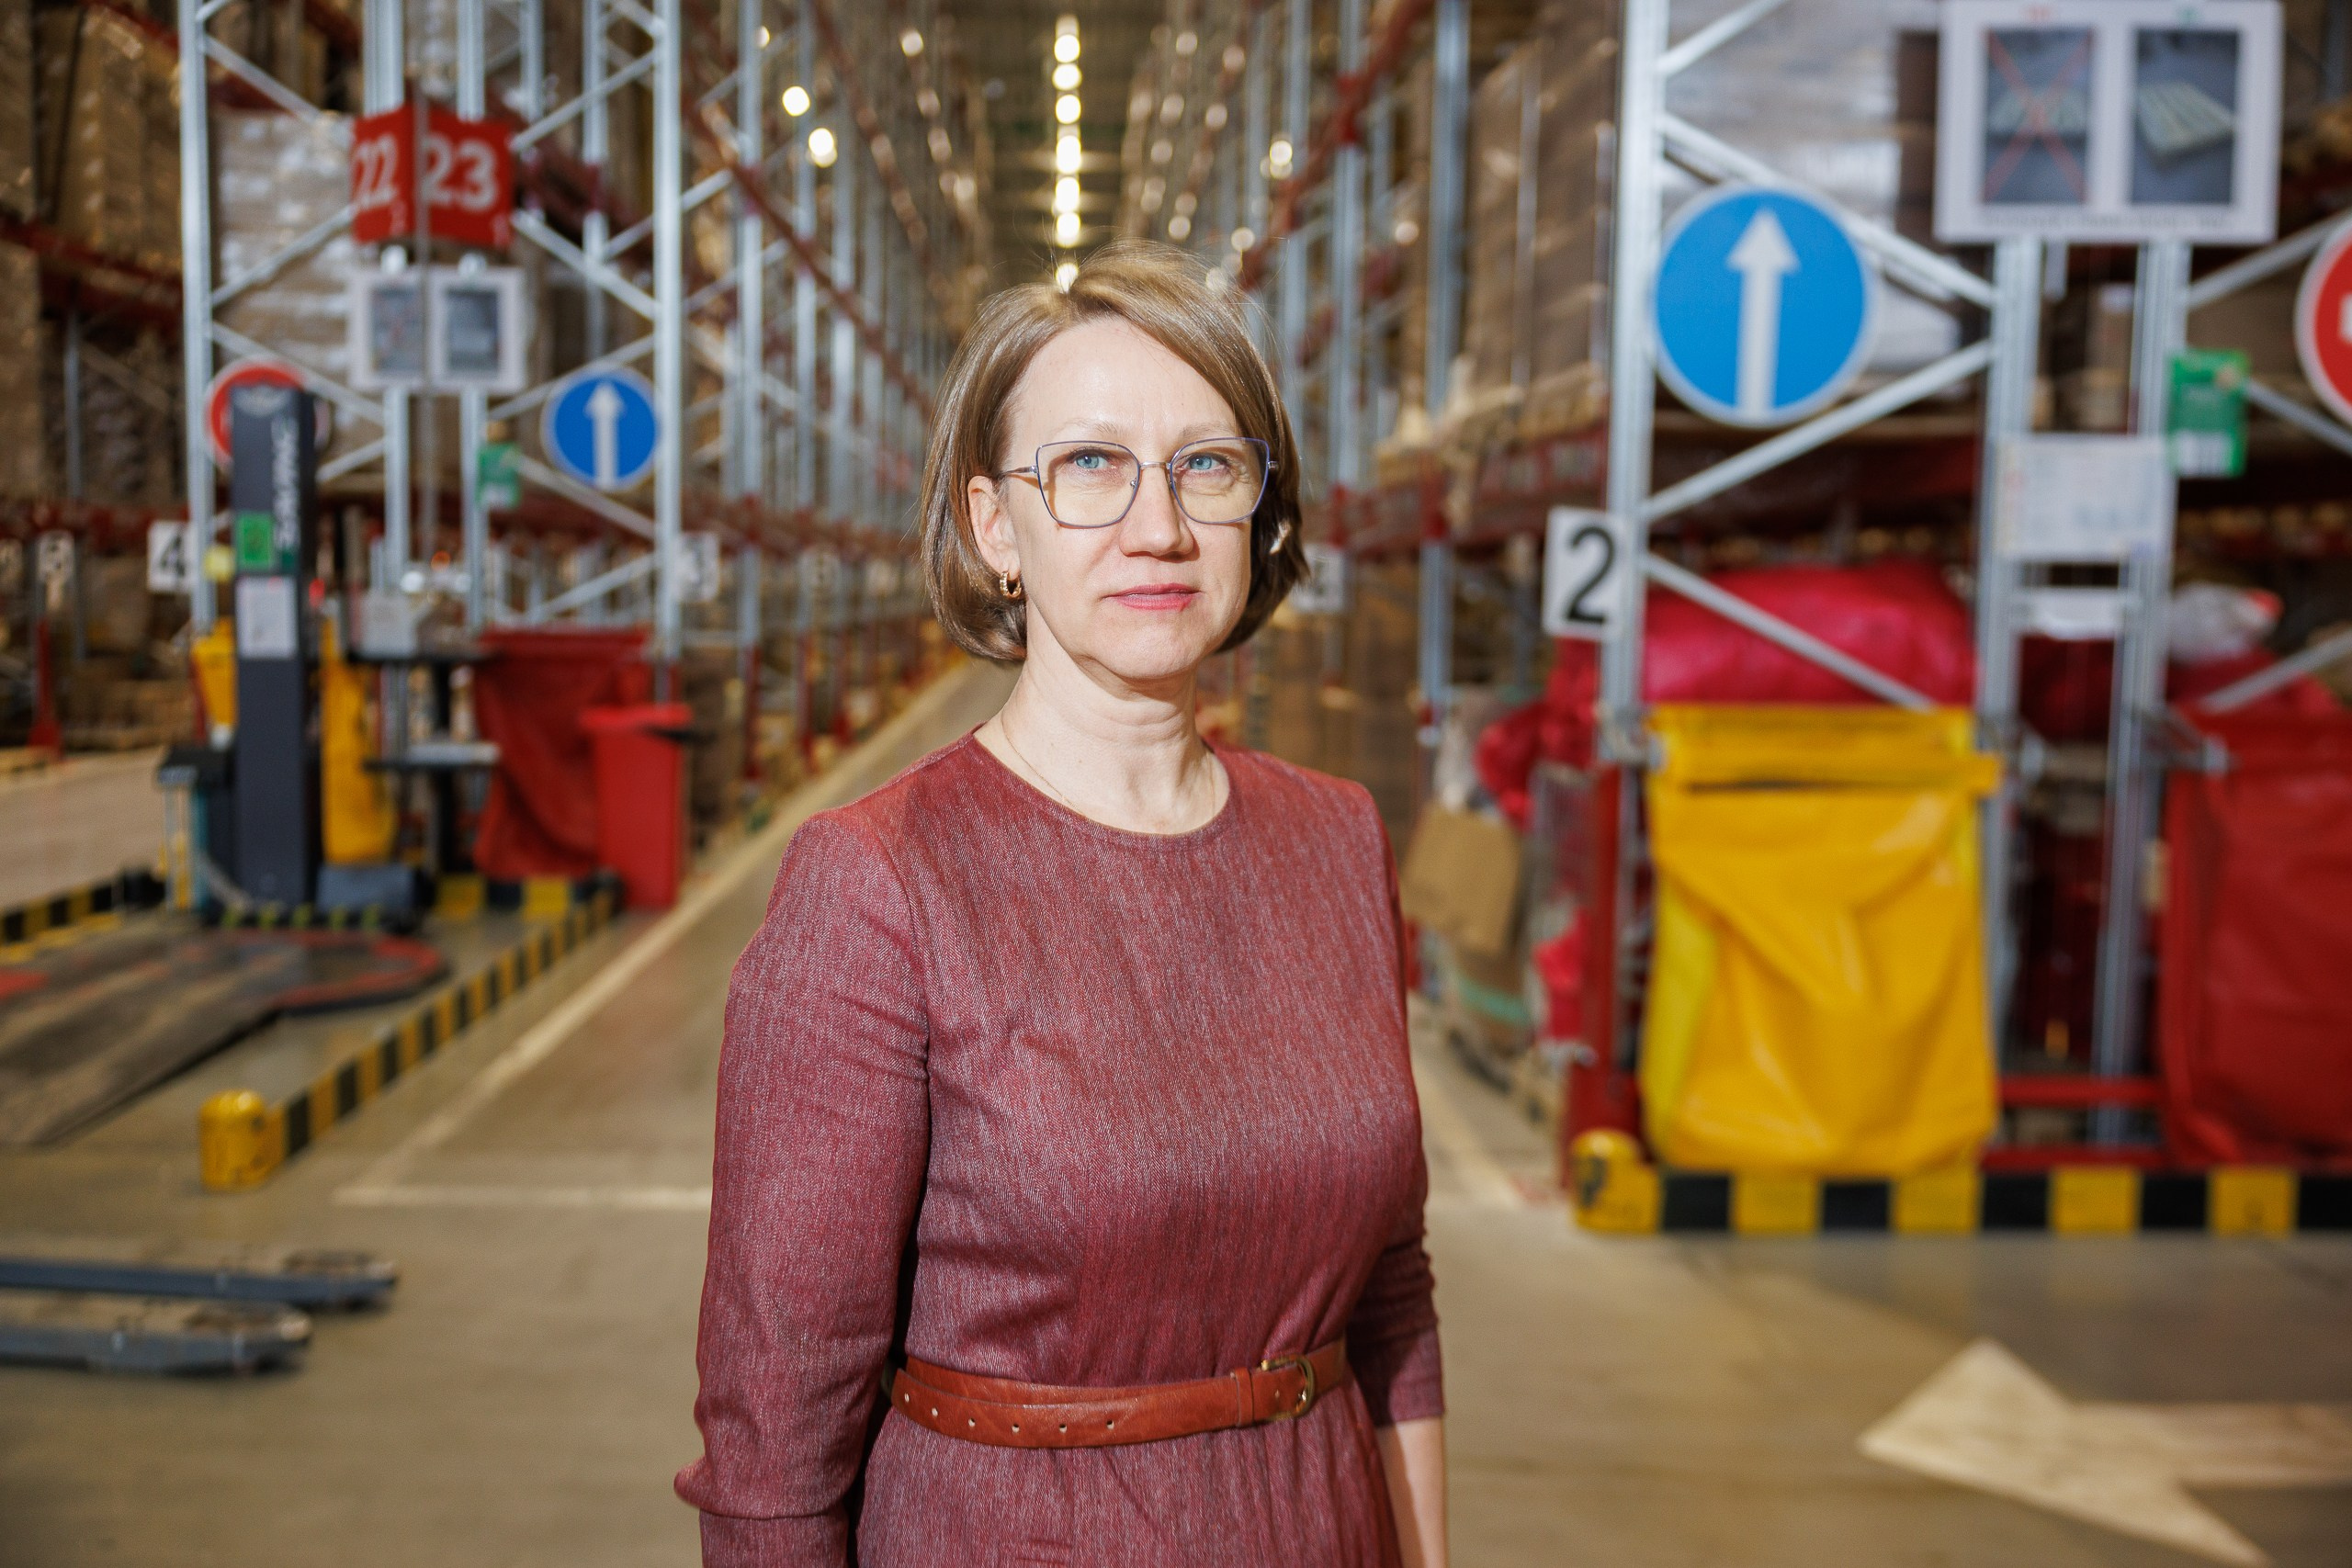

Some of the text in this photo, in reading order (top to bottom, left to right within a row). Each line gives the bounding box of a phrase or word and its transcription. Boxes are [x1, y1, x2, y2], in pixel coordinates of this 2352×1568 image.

[350, 134, 399, 209] 22
[421, 133, 499, 212] 23
[159, 532, 187, 580] 4
[1566, 525, 1616, 626] 2
